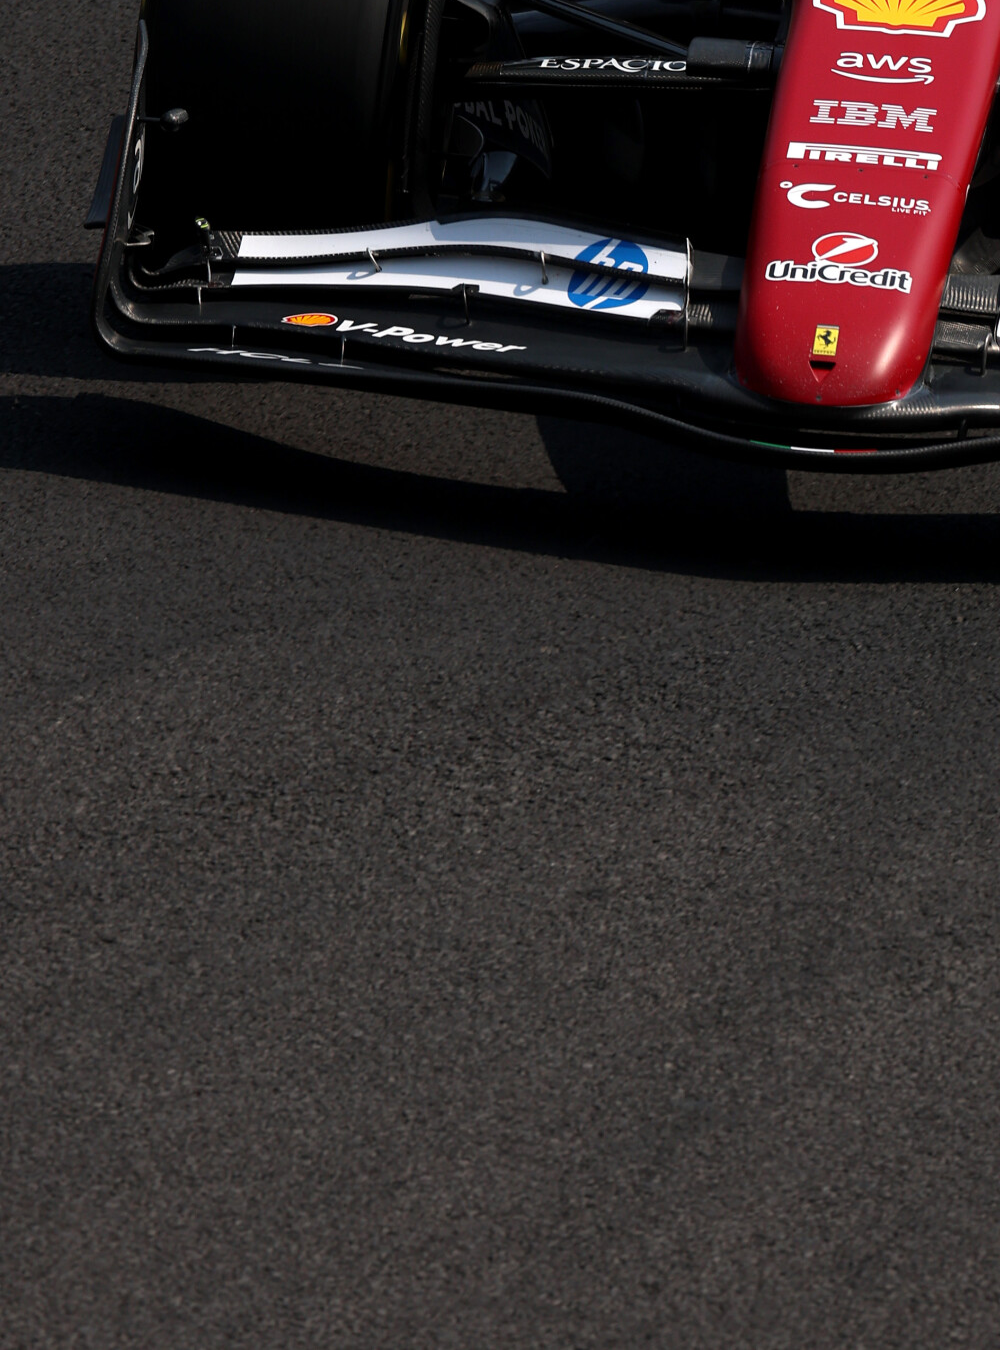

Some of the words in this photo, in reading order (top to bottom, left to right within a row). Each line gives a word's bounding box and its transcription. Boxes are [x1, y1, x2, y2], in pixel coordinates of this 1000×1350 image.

[836, 52, 933, 75] aws
[808, 99, 938, 133] IBM
[786, 141, 943, 171] PIRELLI
[833, 191, 931, 212] CELSIUS
[891, 206, 911, 215] LIVE
[913, 209, 928, 217] FIT
[766, 260, 912, 294] UniCredit
[336, 318, 526, 354] V-Power
